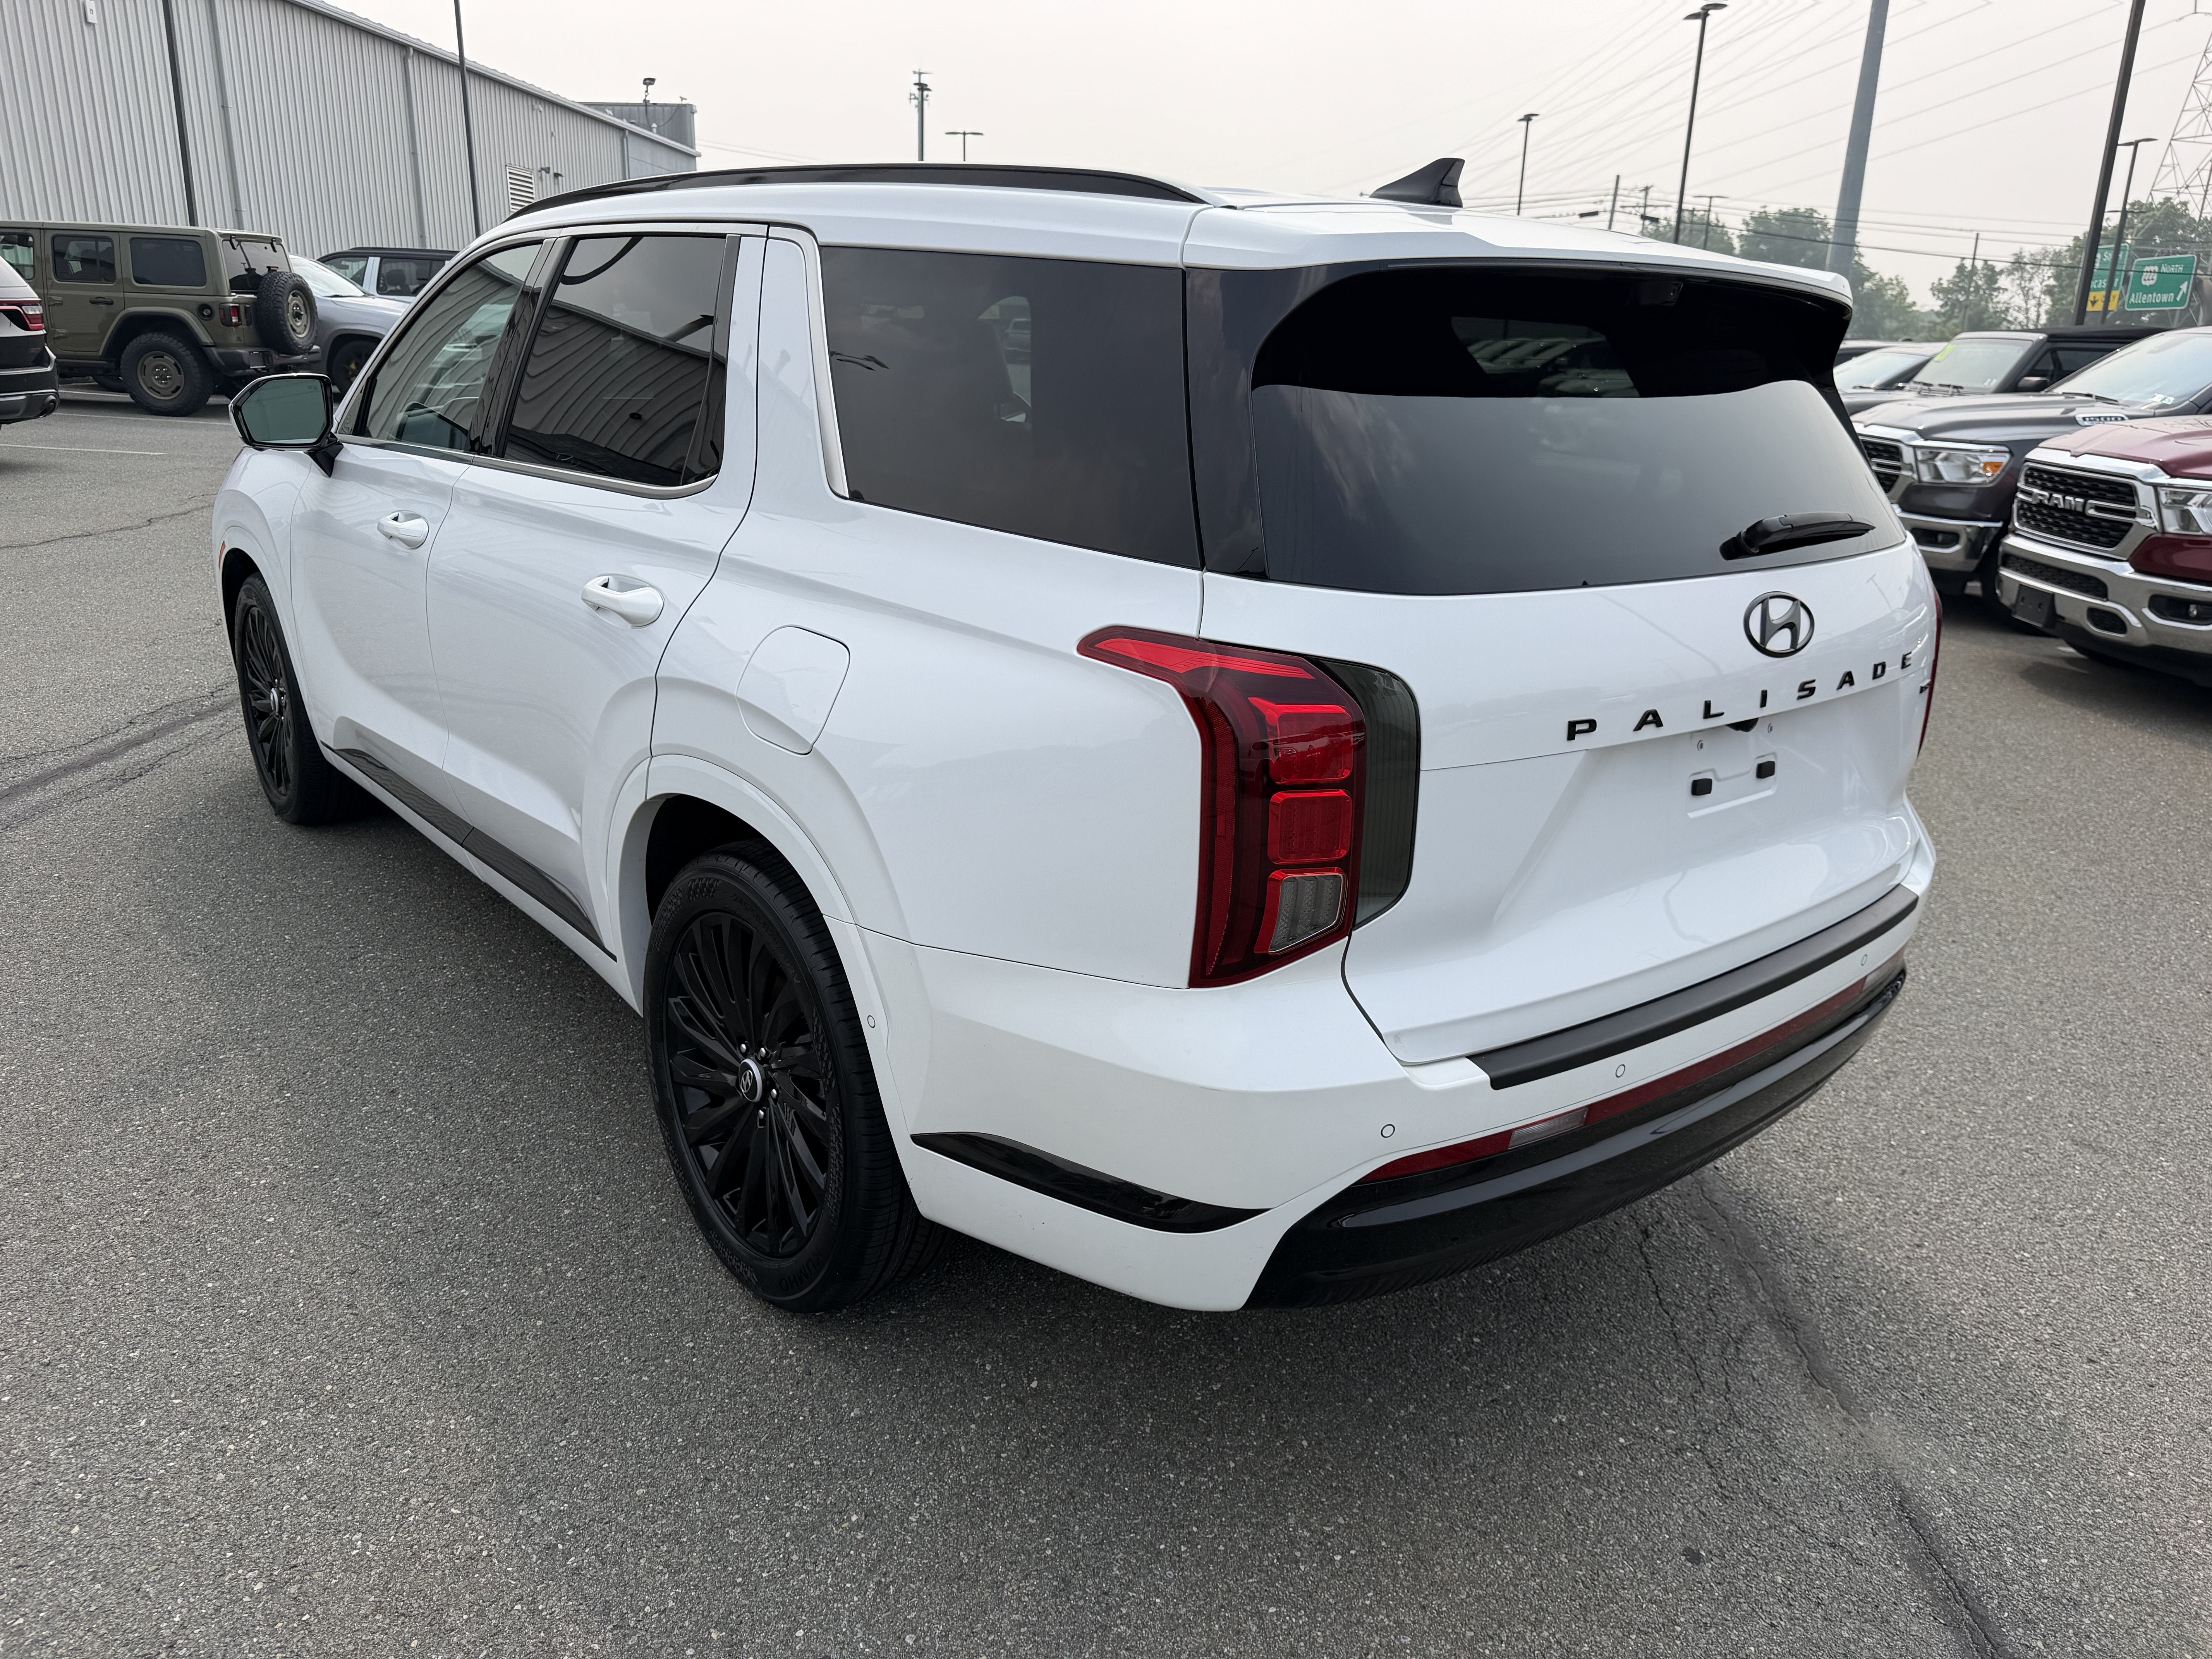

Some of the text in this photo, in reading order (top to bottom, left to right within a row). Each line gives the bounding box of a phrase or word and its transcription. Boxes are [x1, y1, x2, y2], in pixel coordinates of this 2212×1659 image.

[2129, 292, 2174, 304] Allentown
[2033, 489, 2084, 512] RAM
[1566, 650, 1913, 741] PALISADE
